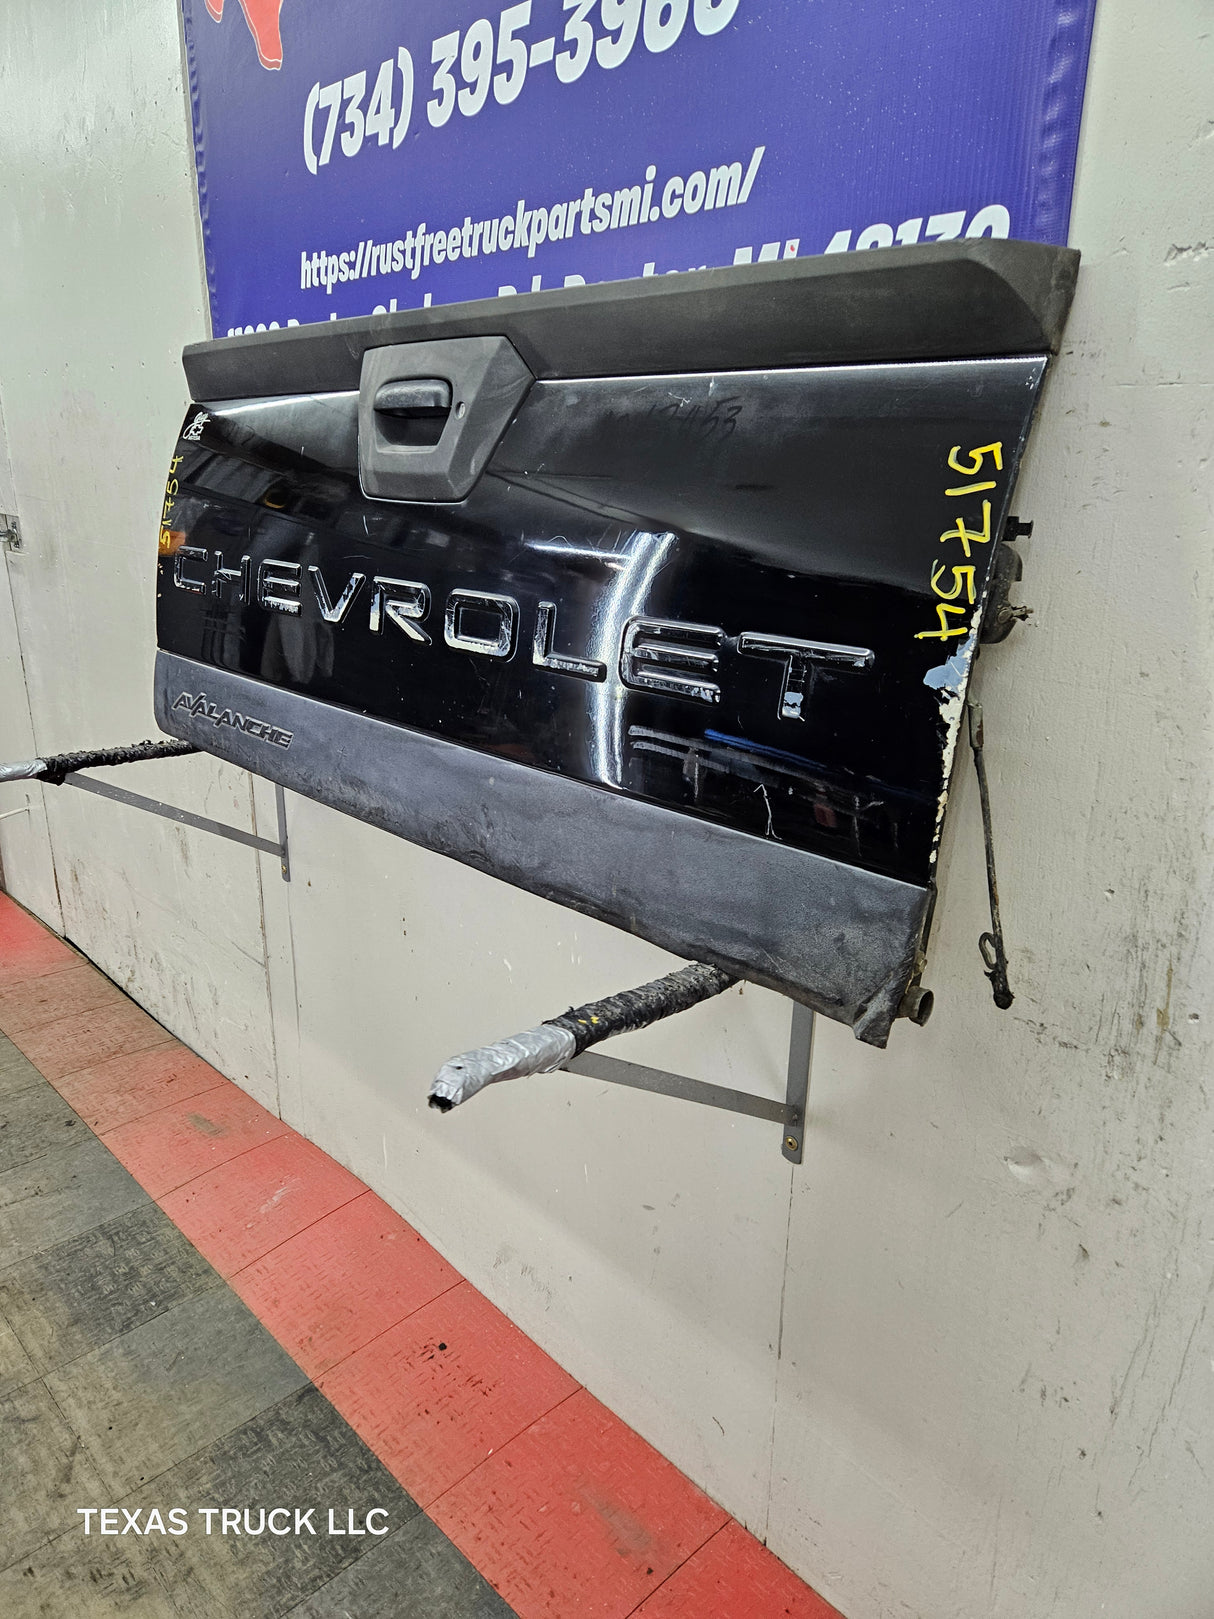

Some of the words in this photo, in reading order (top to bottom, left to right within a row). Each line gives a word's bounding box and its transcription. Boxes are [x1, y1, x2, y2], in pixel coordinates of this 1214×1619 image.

[303, 46, 414, 175] (734)
[301, 146, 766, 295] https://rustfreetruckpartsmi.com/
[160, 455, 184, 549] 51754
[914, 441, 1003, 642] 51754
[173, 545, 875, 722] CHEVROLET
[172, 691, 294, 750] AVALANCHE
